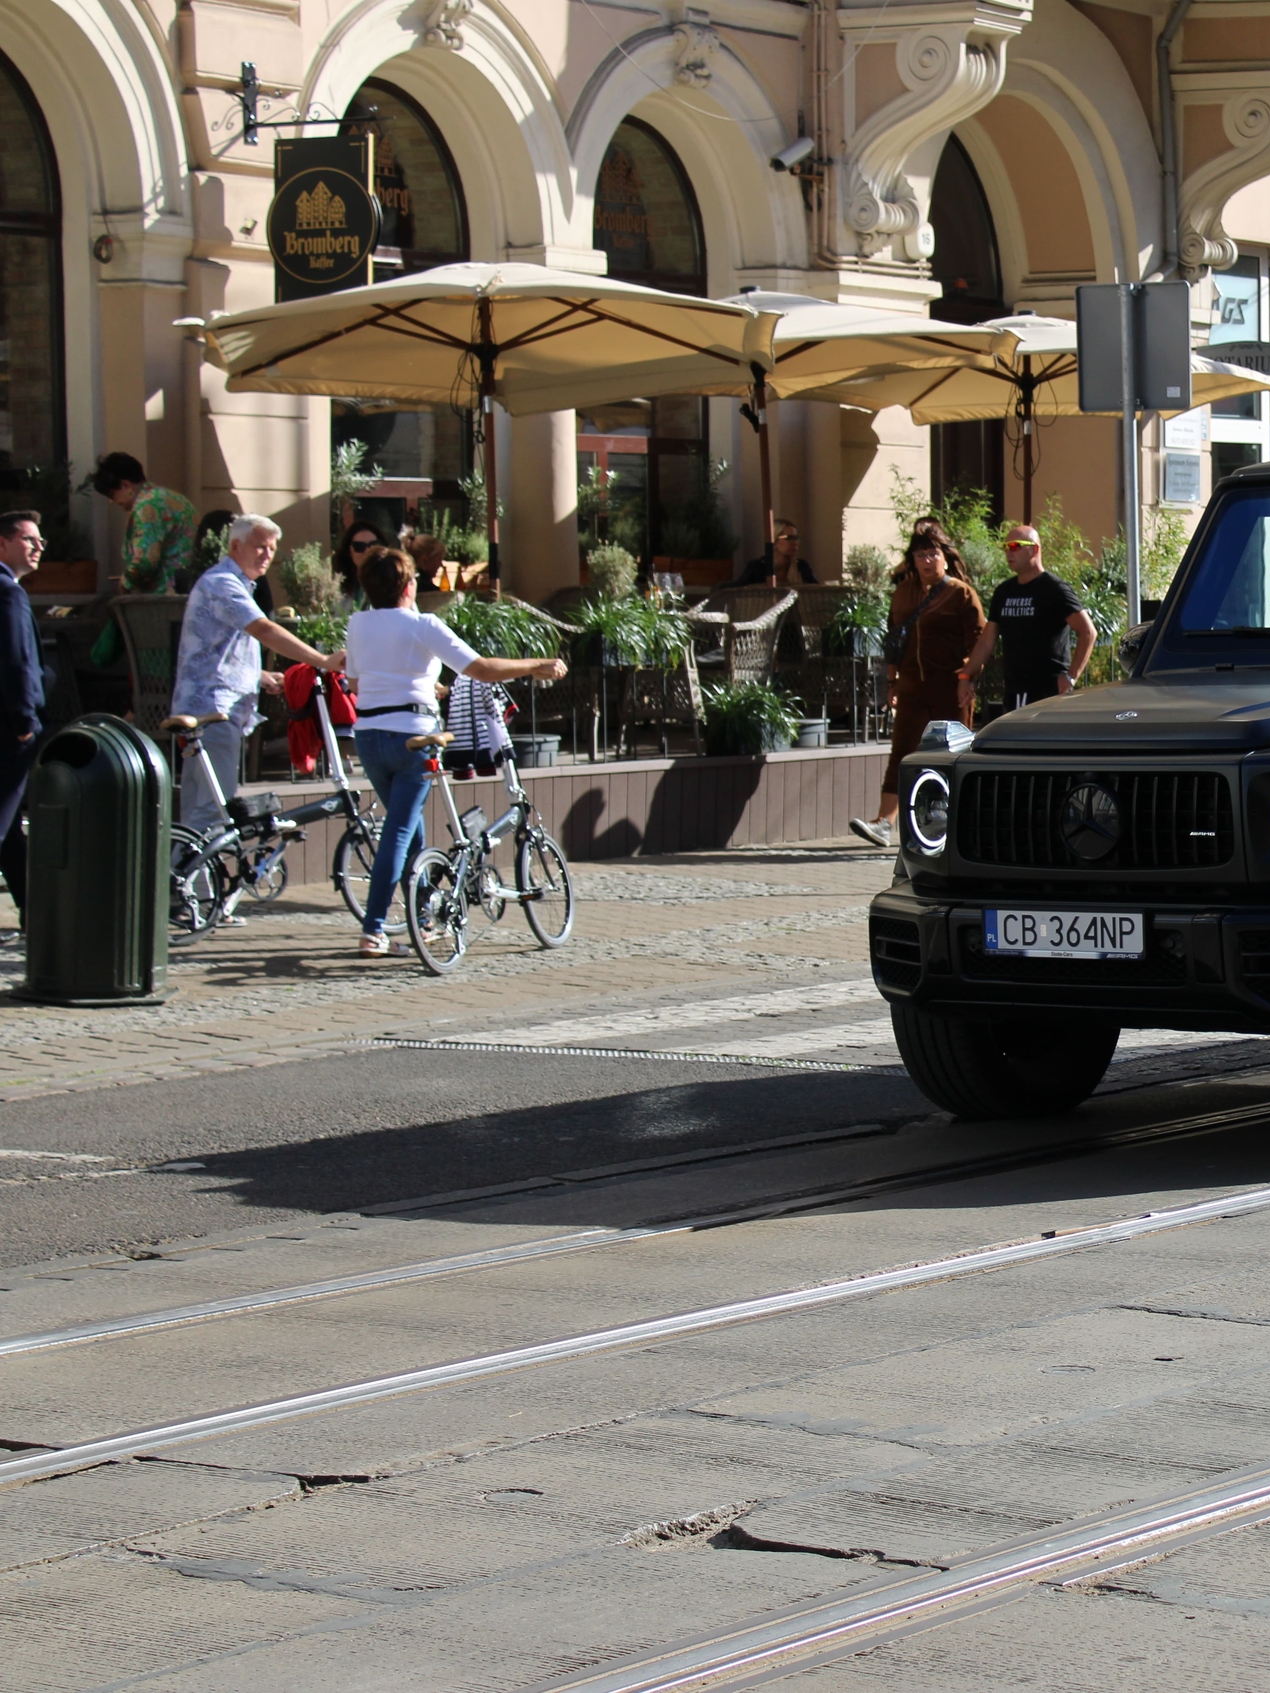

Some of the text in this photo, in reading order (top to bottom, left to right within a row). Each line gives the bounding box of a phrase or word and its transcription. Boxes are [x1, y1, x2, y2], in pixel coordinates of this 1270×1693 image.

[283, 229, 360, 259] Bromberg
[921, 233, 931, 245] 16
[309, 255, 335, 269] Kaffee
[1005, 597, 1033, 607] DIVERSE
[1001, 607, 1035, 617] ATHLETICS
[1003, 913, 1136, 949] CB 364NP
[987, 933, 997, 943] PL
